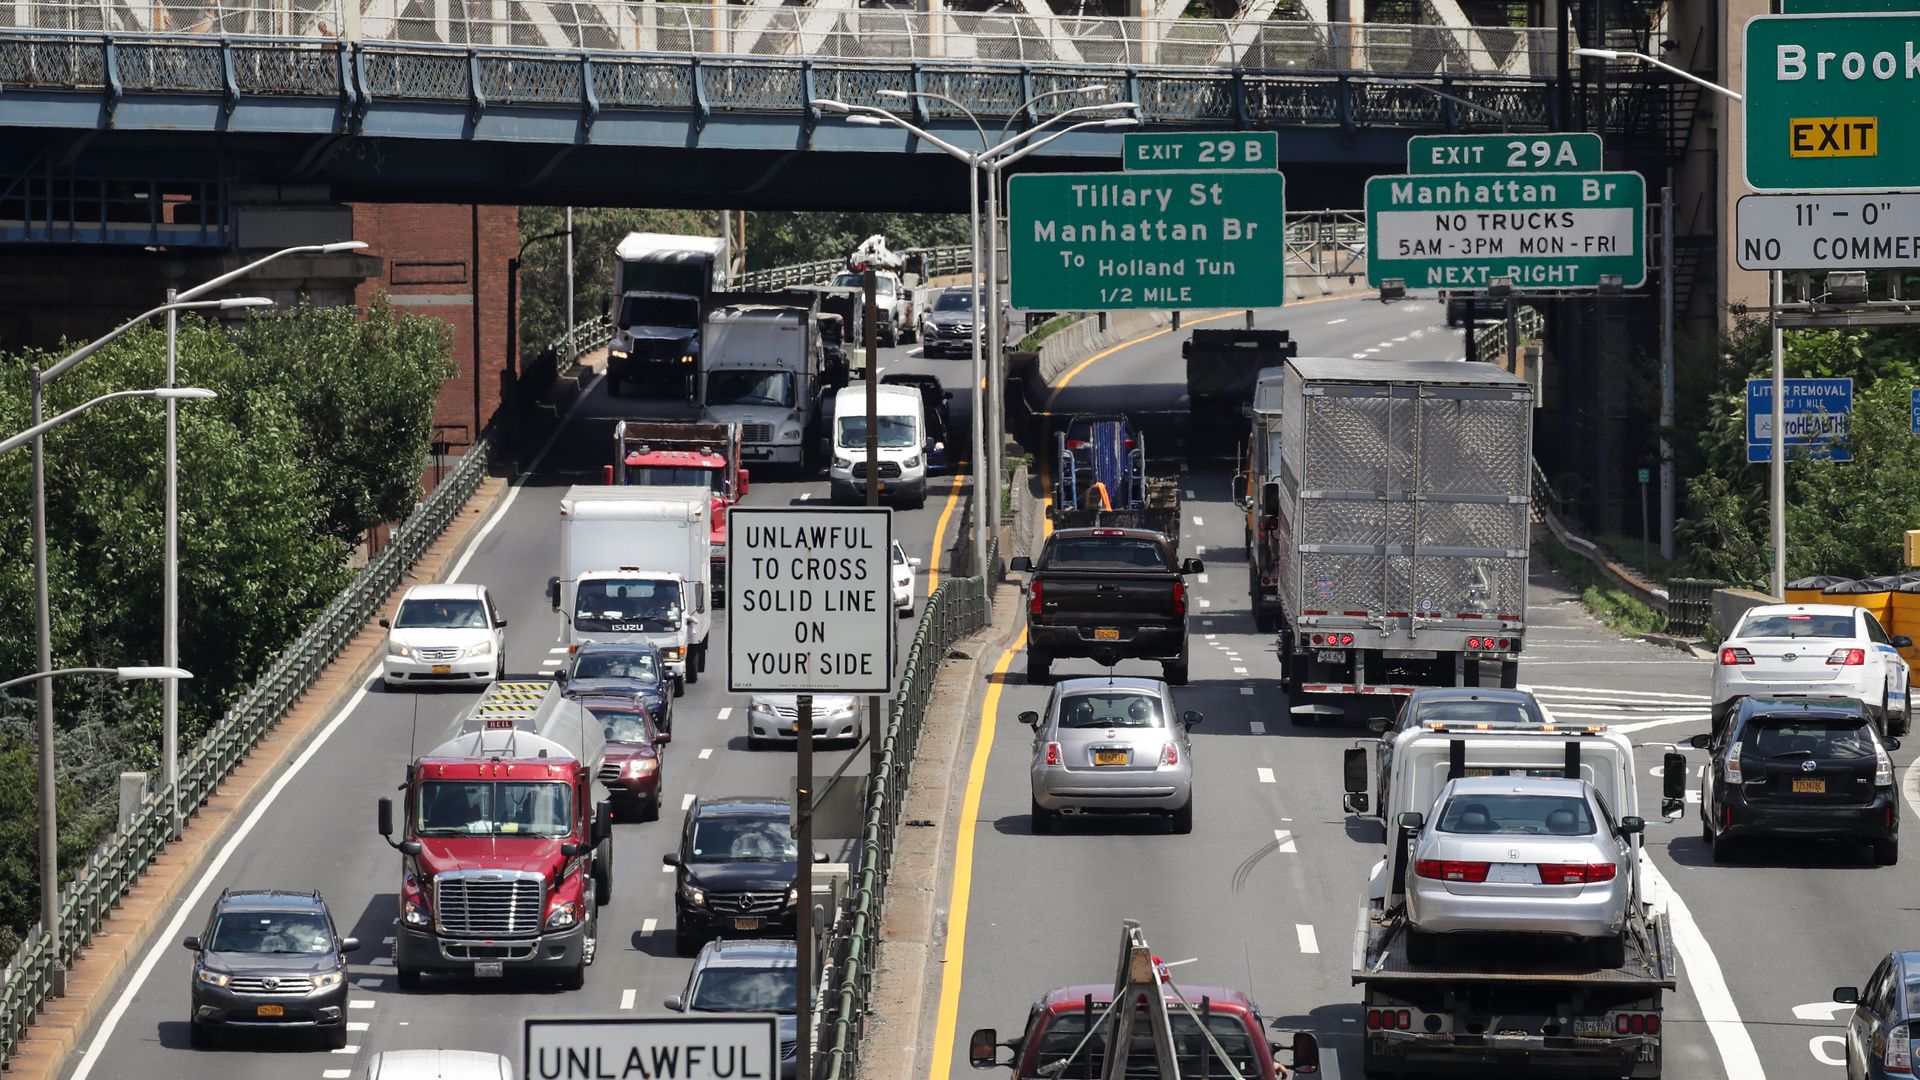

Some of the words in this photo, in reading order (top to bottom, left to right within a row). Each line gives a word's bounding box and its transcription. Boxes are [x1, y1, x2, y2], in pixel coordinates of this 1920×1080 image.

[1778, 42, 1920, 80] Brook
[1794, 124, 1873, 151] EXIT
[1139, 145, 1182, 159] EXIT
[1432, 147, 1484, 164] EXIT
[1507, 141, 1577, 167] 29A
[1072, 185, 1172, 211] Tillary
[1190, 183, 1222, 205] St
[1391, 182, 1557, 204] Manhattan
[1582, 179, 1617, 200] Br
[1437, 215, 1466, 231] NO
[1477, 212, 1574, 230] TRUCKS
[1796, 204, 1819, 226] 11'
[1035, 220, 1206, 242] Manhattan
[1224, 218, 1257, 240] Br
[1746, 239, 1780, 260] NO
[1060, 251, 1084, 267] To
[1099, 259, 1184, 276] Holland
[1196, 259, 1234, 275] Tun
[1427, 266, 1490, 284] NEXT
[1507, 265, 1579, 283] RIGHT
[1101, 288, 1132, 302] 1/2
[1144, 287, 1191, 301] MILE
[1753, 385, 1790, 397] LITTR
[1794, 386, 1845, 395] REMOVAL
[1783, 416, 1843, 434] roHEALTH
[746, 526, 873, 549] UNLAWFUL
[753, 558, 778, 579] TO
[792, 558, 866, 580] CROSS
[744, 590, 811, 611] SOLID
[826, 591, 875, 611] LINE
[612, 623, 644, 631] ISUZU
[795, 622, 824, 643] ON
[748, 653, 807, 674] YOUR
[821, 653, 872, 674] SIDE
[540, 1046, 761, 1079] UNLAWFUL
